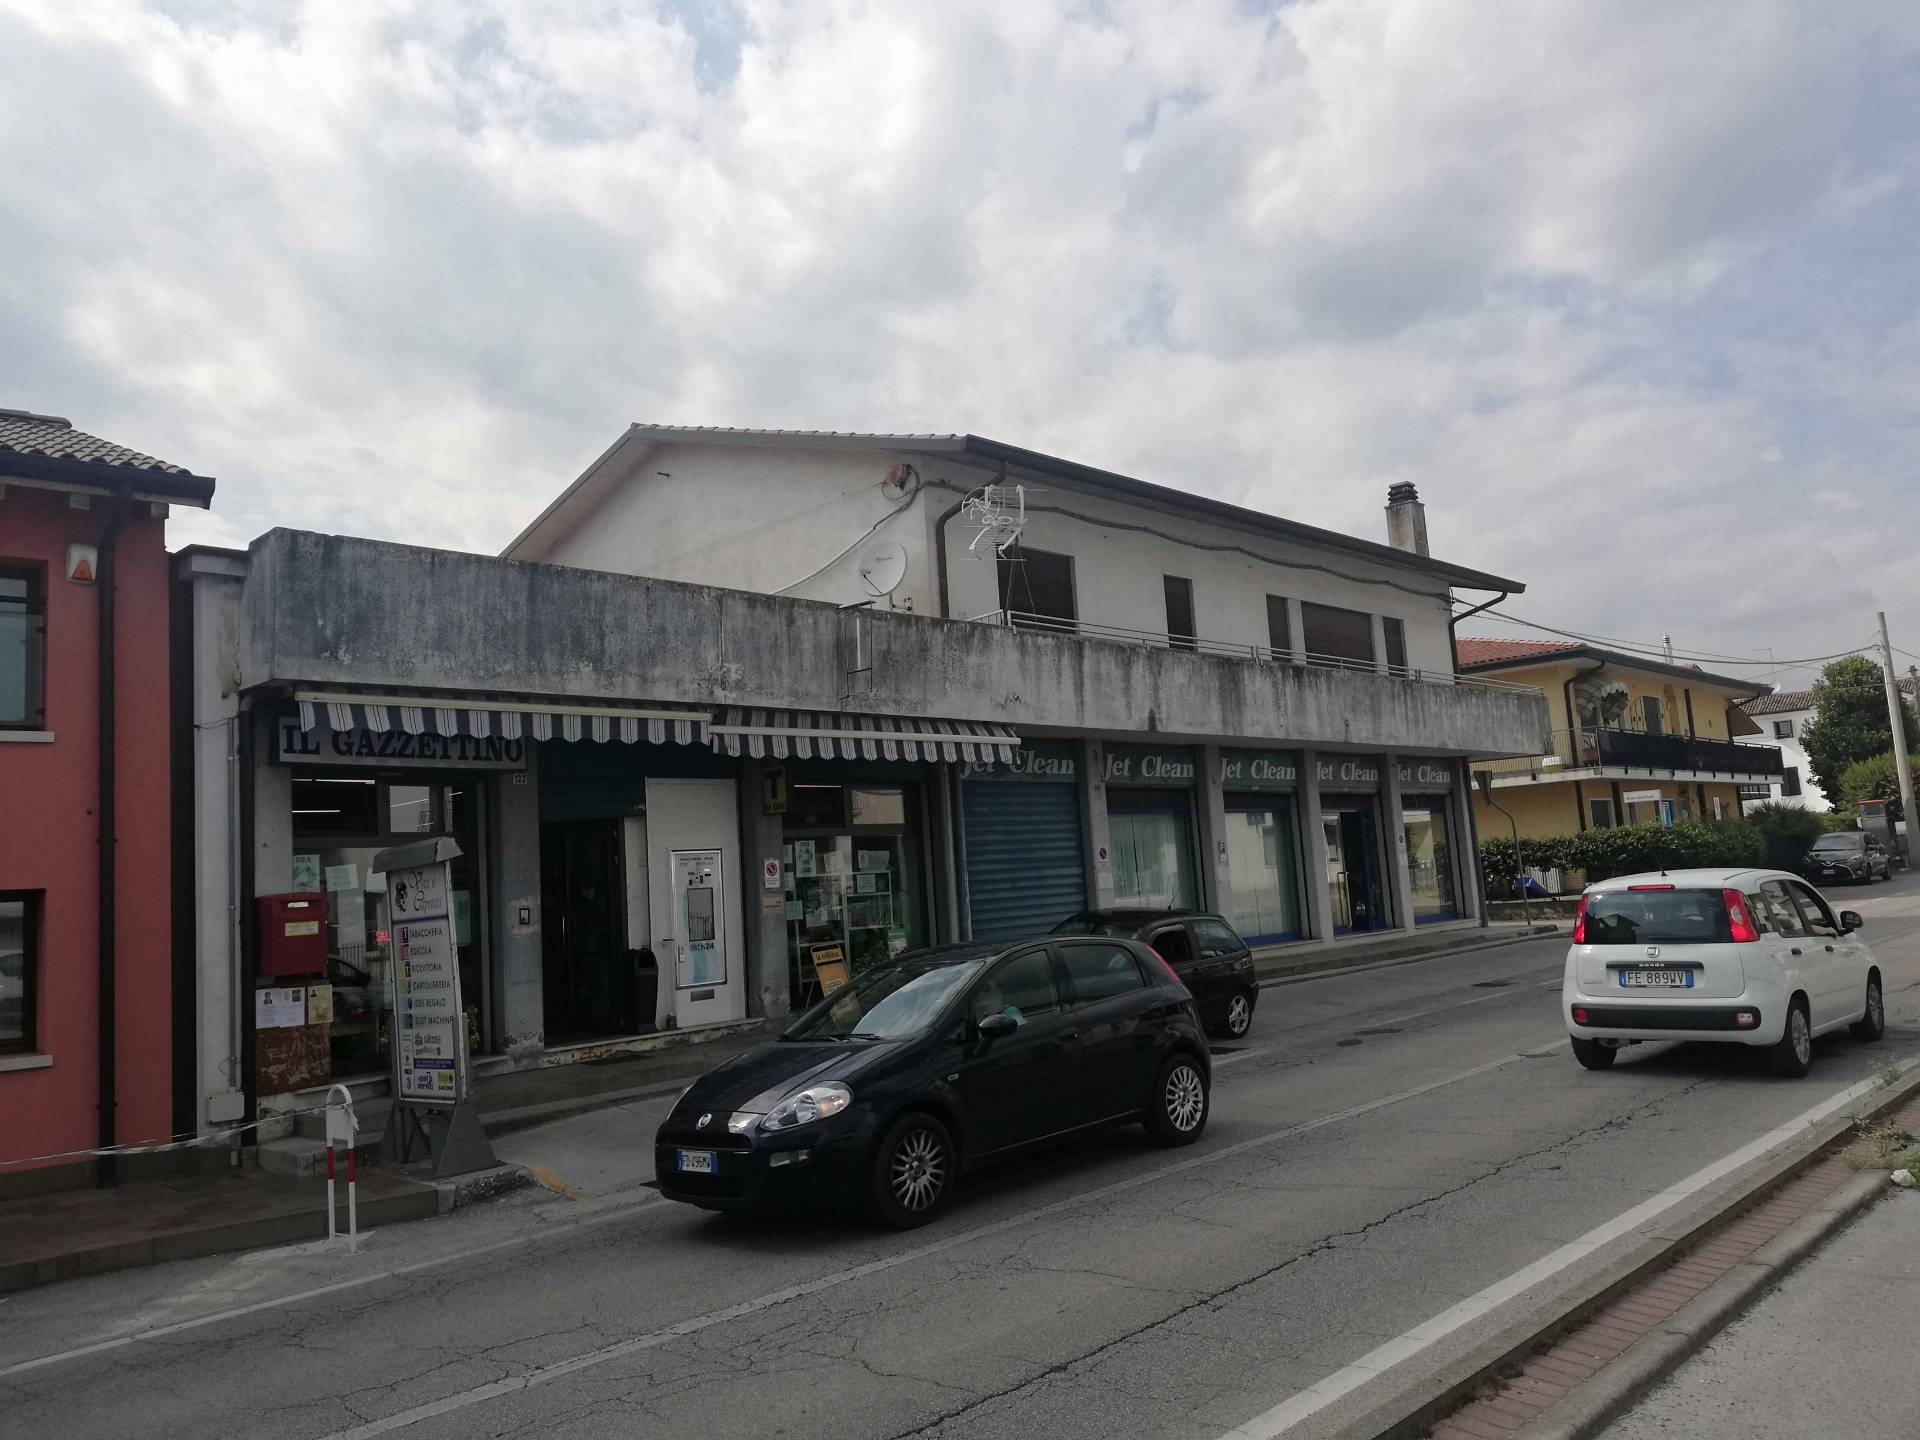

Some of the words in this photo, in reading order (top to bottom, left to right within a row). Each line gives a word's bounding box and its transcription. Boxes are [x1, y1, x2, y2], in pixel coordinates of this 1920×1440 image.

[283, 724, 320, 756] IL
[331, 729, 523, 761] GAZZETTINO
[1009, 749, 1075, 776] Clean
[1104, 754, 1131, 780] Jet
[1141, 757, 1194, 779] Clean
[1220, 758, 1242, 780] Jet
[1251, 759, 1297, 781] Clean
[514, 775, 526, 783] 122
[1316, 761, 1333, 782] Jet
[1341, 762, 1378, 782] Clean
[1417, 765, 1451, 783] Clean
[765, 770, 783, 799] T
[410, 927, 443, 938] TABACCHERIA
[410, 946, 432, 956] EDICOLA
[412, 962, 442, 974] RICEVITORIA
[412, 980, 451, 991] CARTOLIBRERIA
[1627, 973, 1641, 984] FE
[1646, 973, 1685, 985] 889WV
[414, 999, 425, 1008] IDEE
[426, 998, 446, 1007] REGALO
